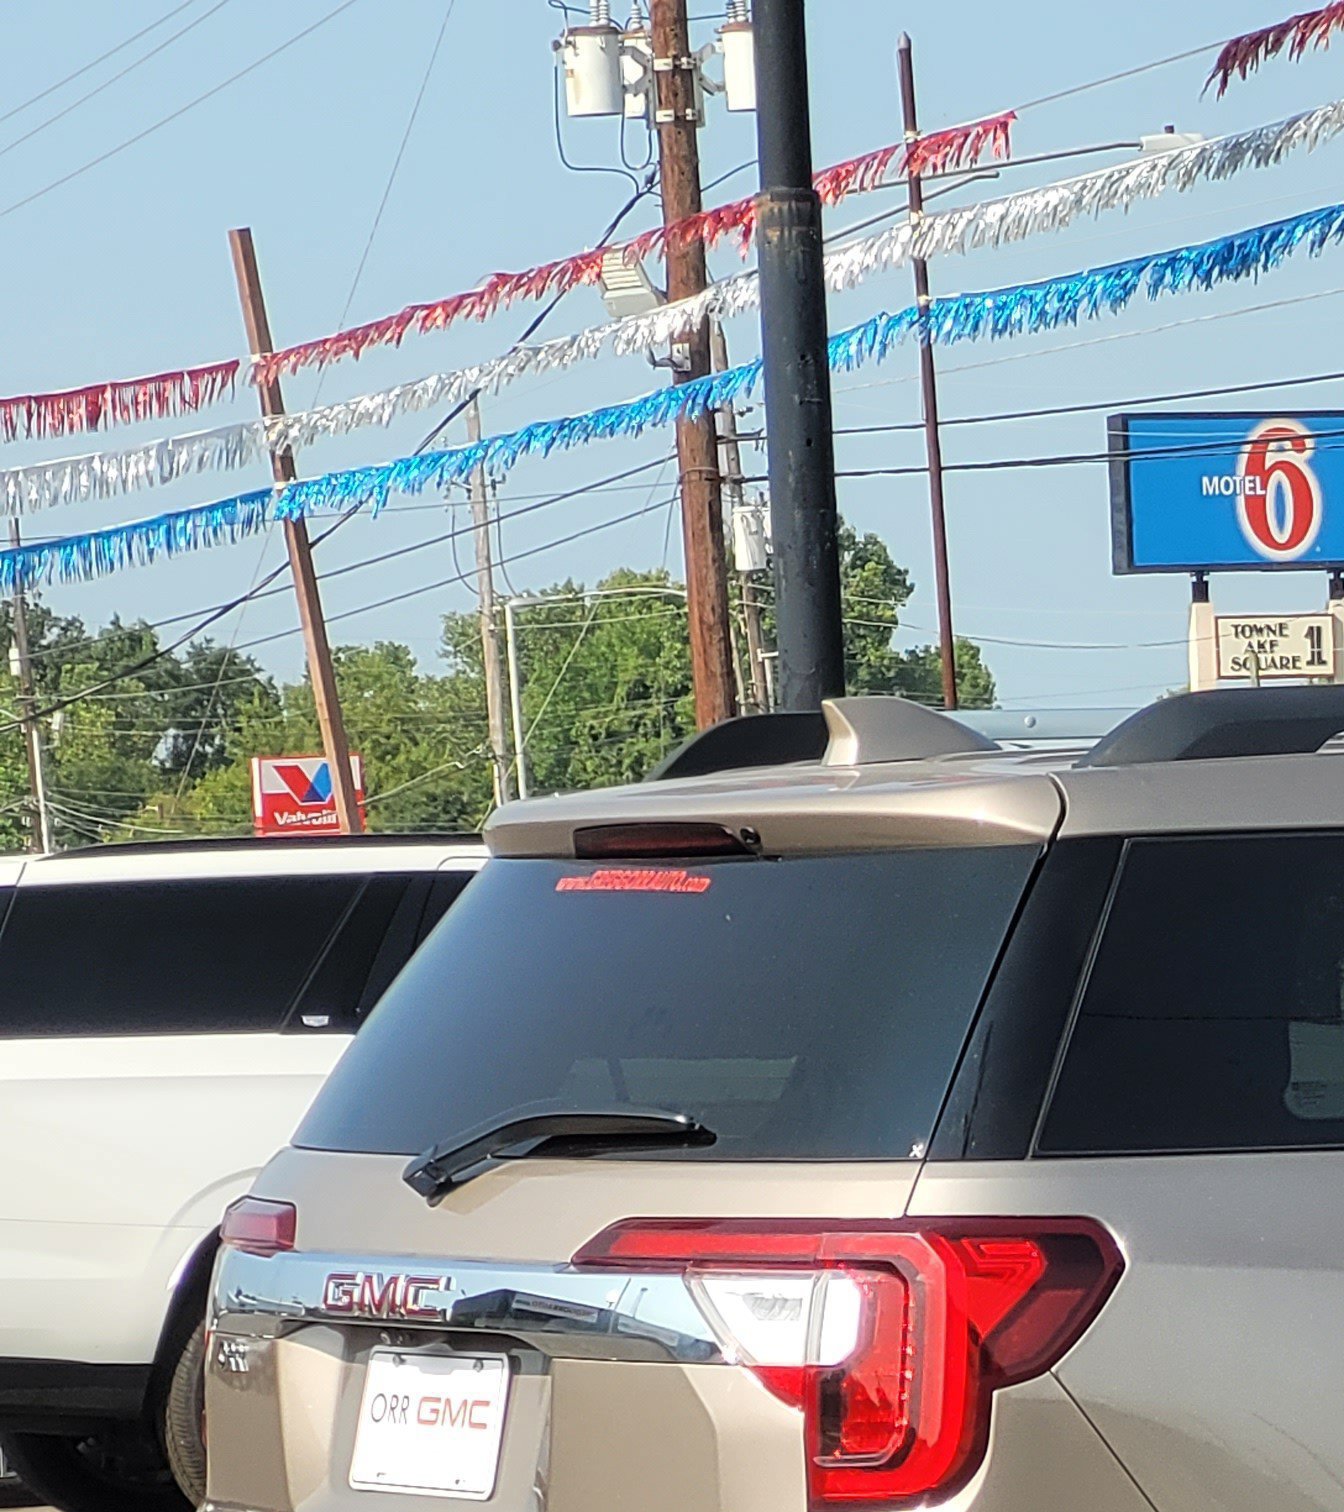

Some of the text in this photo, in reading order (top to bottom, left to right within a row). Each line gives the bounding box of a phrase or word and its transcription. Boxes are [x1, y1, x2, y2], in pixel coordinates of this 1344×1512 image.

[1201, 475, 1266, 496] MOTEL
[1244, 426, 1314, 552] 6
[1230, 622, 1290, 639] TOWNE
[322, 1271, 457, 1322] GMC
[371, 1393, 491, 1430] ORR GMC
